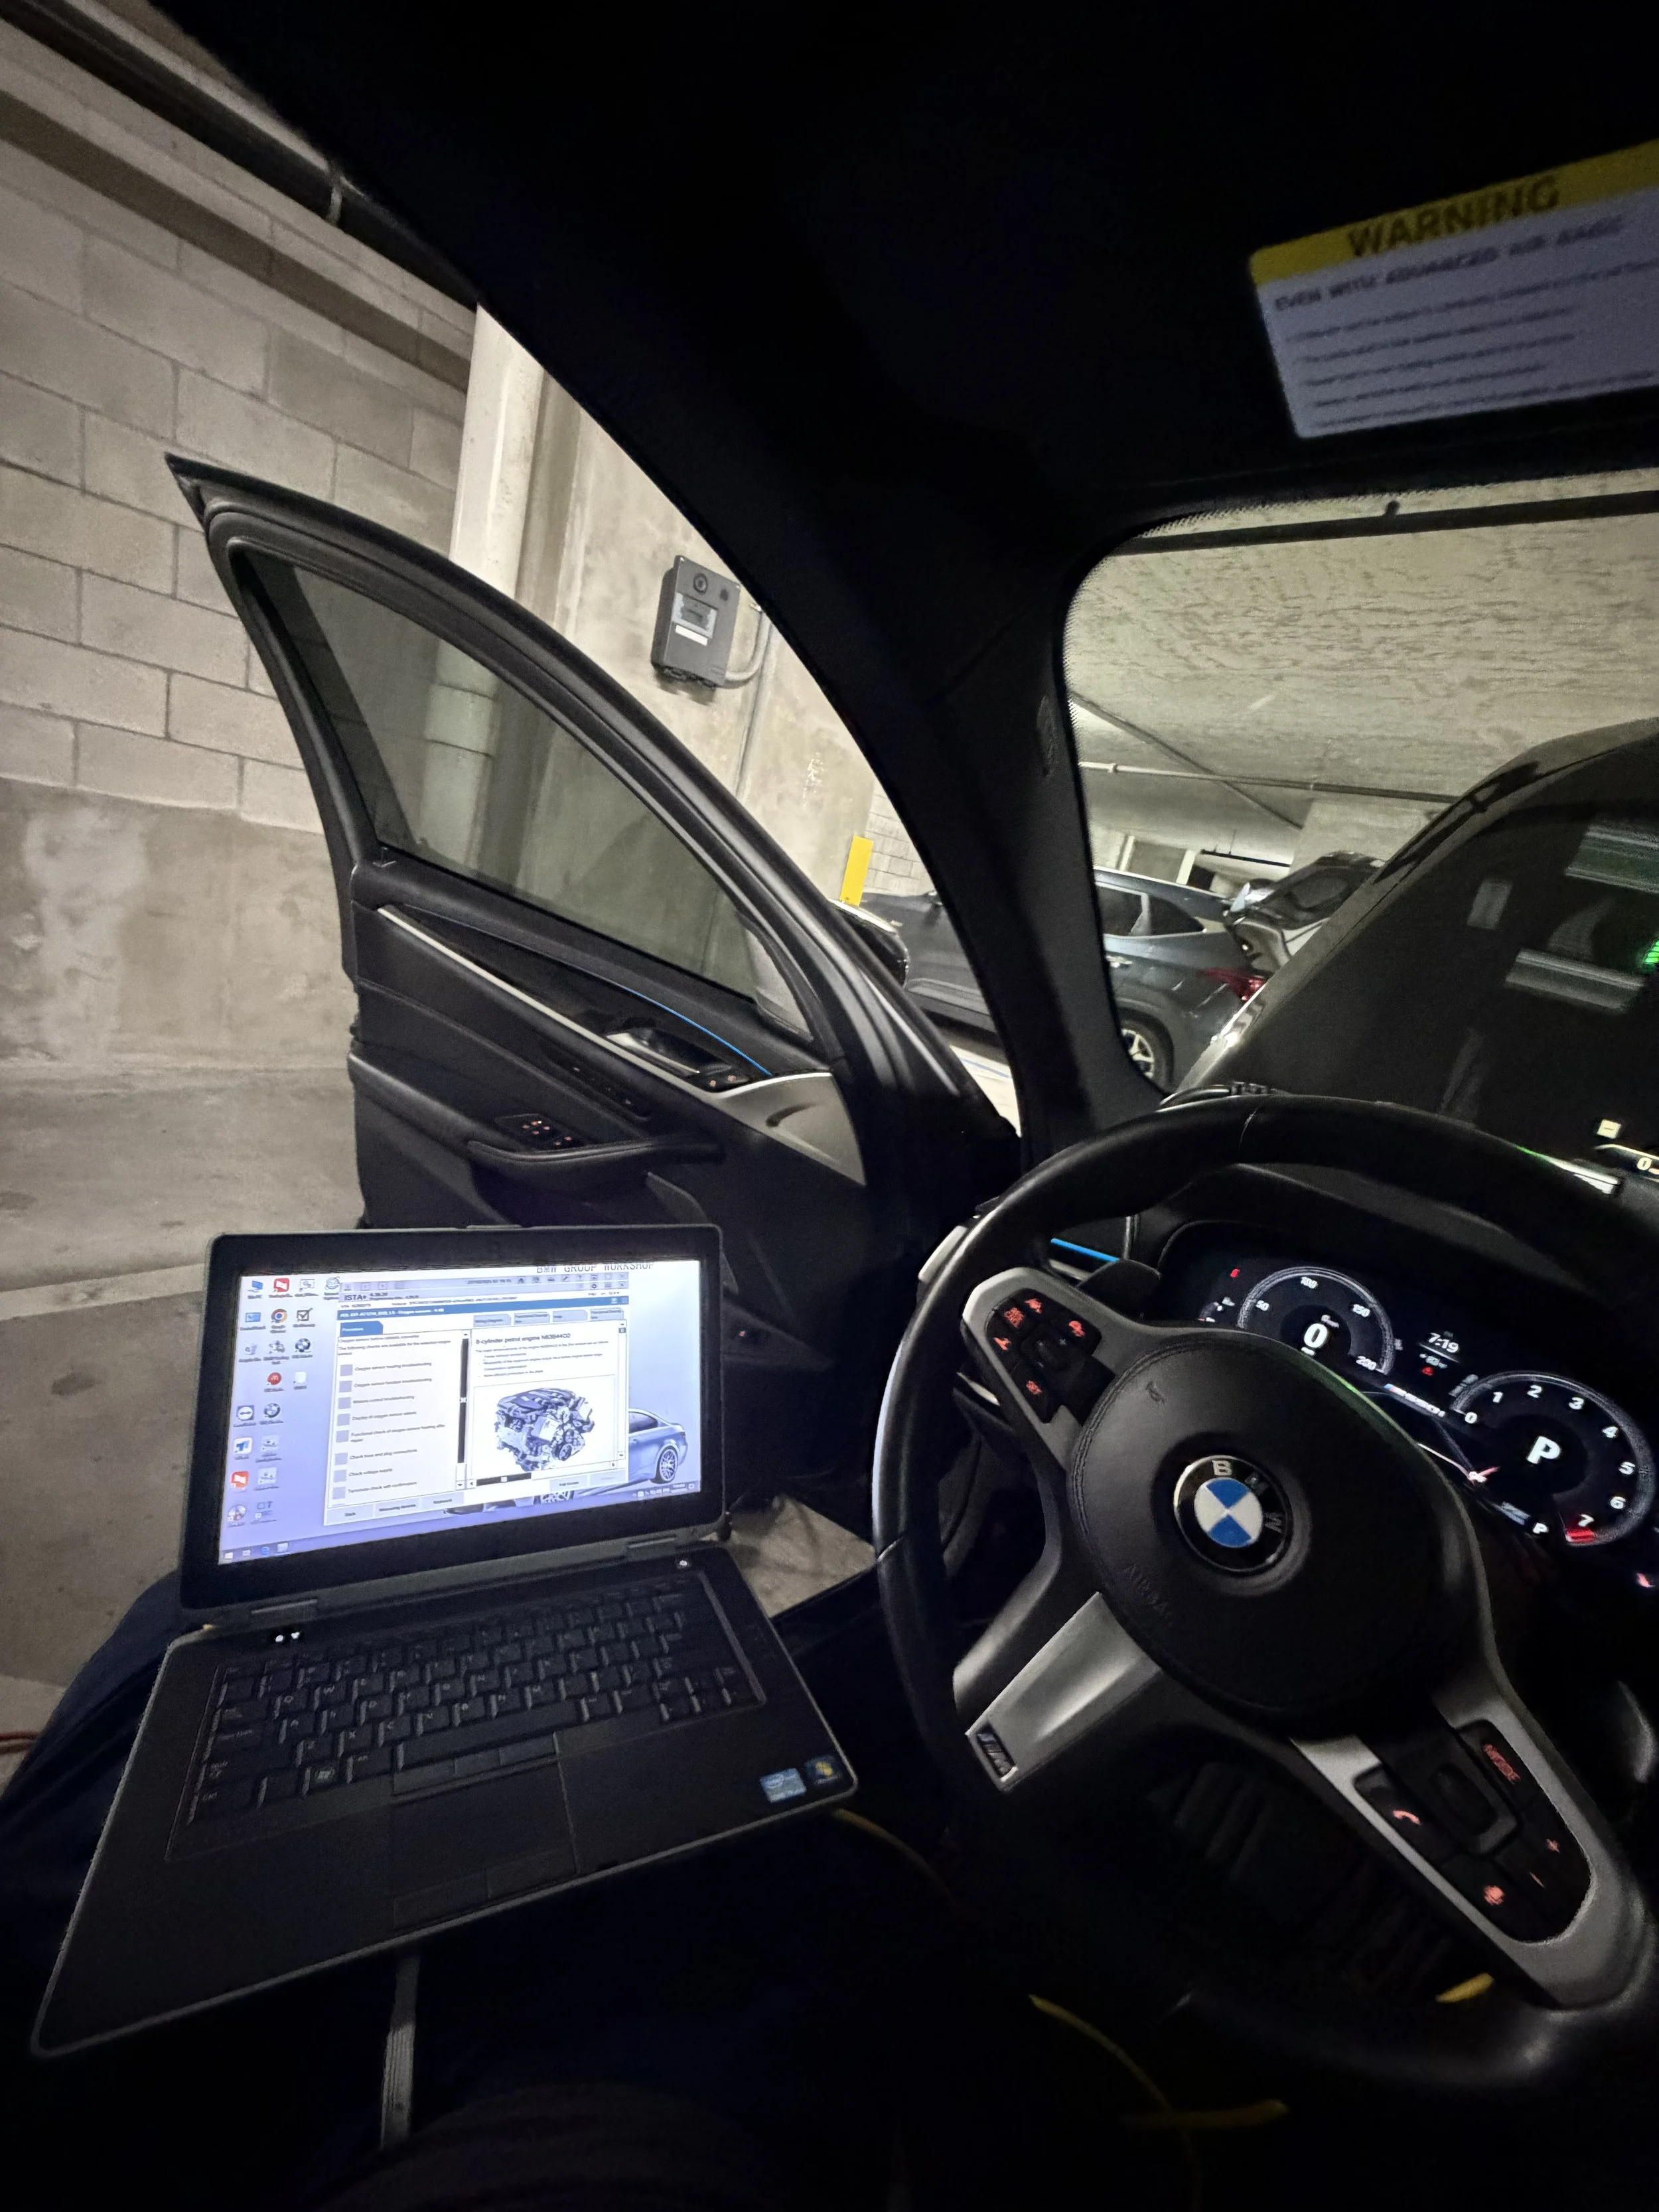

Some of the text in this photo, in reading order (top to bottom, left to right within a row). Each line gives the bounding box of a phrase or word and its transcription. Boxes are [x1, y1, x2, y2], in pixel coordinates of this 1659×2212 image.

[1346, 175, 1559, 256] WARNING
[564, 1264, 597, 1273] GROUP
[604, 1262, 654, 1271] WORKSHOP
[1301, 1276, 1318, 1289] 100
[1256, 1300, 1269, 1311] 50
[1352, 1304, 1370, 1317] 150
[1303, 1323, 1328, 1349] 0
[1428, 1333, 1459, 1353] 7:19
[1492, 1391, 1503, 1403] 1
[1527, 1384, 1542, 1398] 2
[1569, 1397, 1584, 1410] 3
[1465, 1411, 1478, 1424] 0
[1602, 1426, 1619, 1439] 4
[1527, 1436, 1561, 1465] P
[1619, 1461, 1636, 1475] 5
[1212, 1459, 1284, 1534] BMW
[1610, 1496, 1626, 1510] 6
[1578, 1513, 1594, 1527] 7
